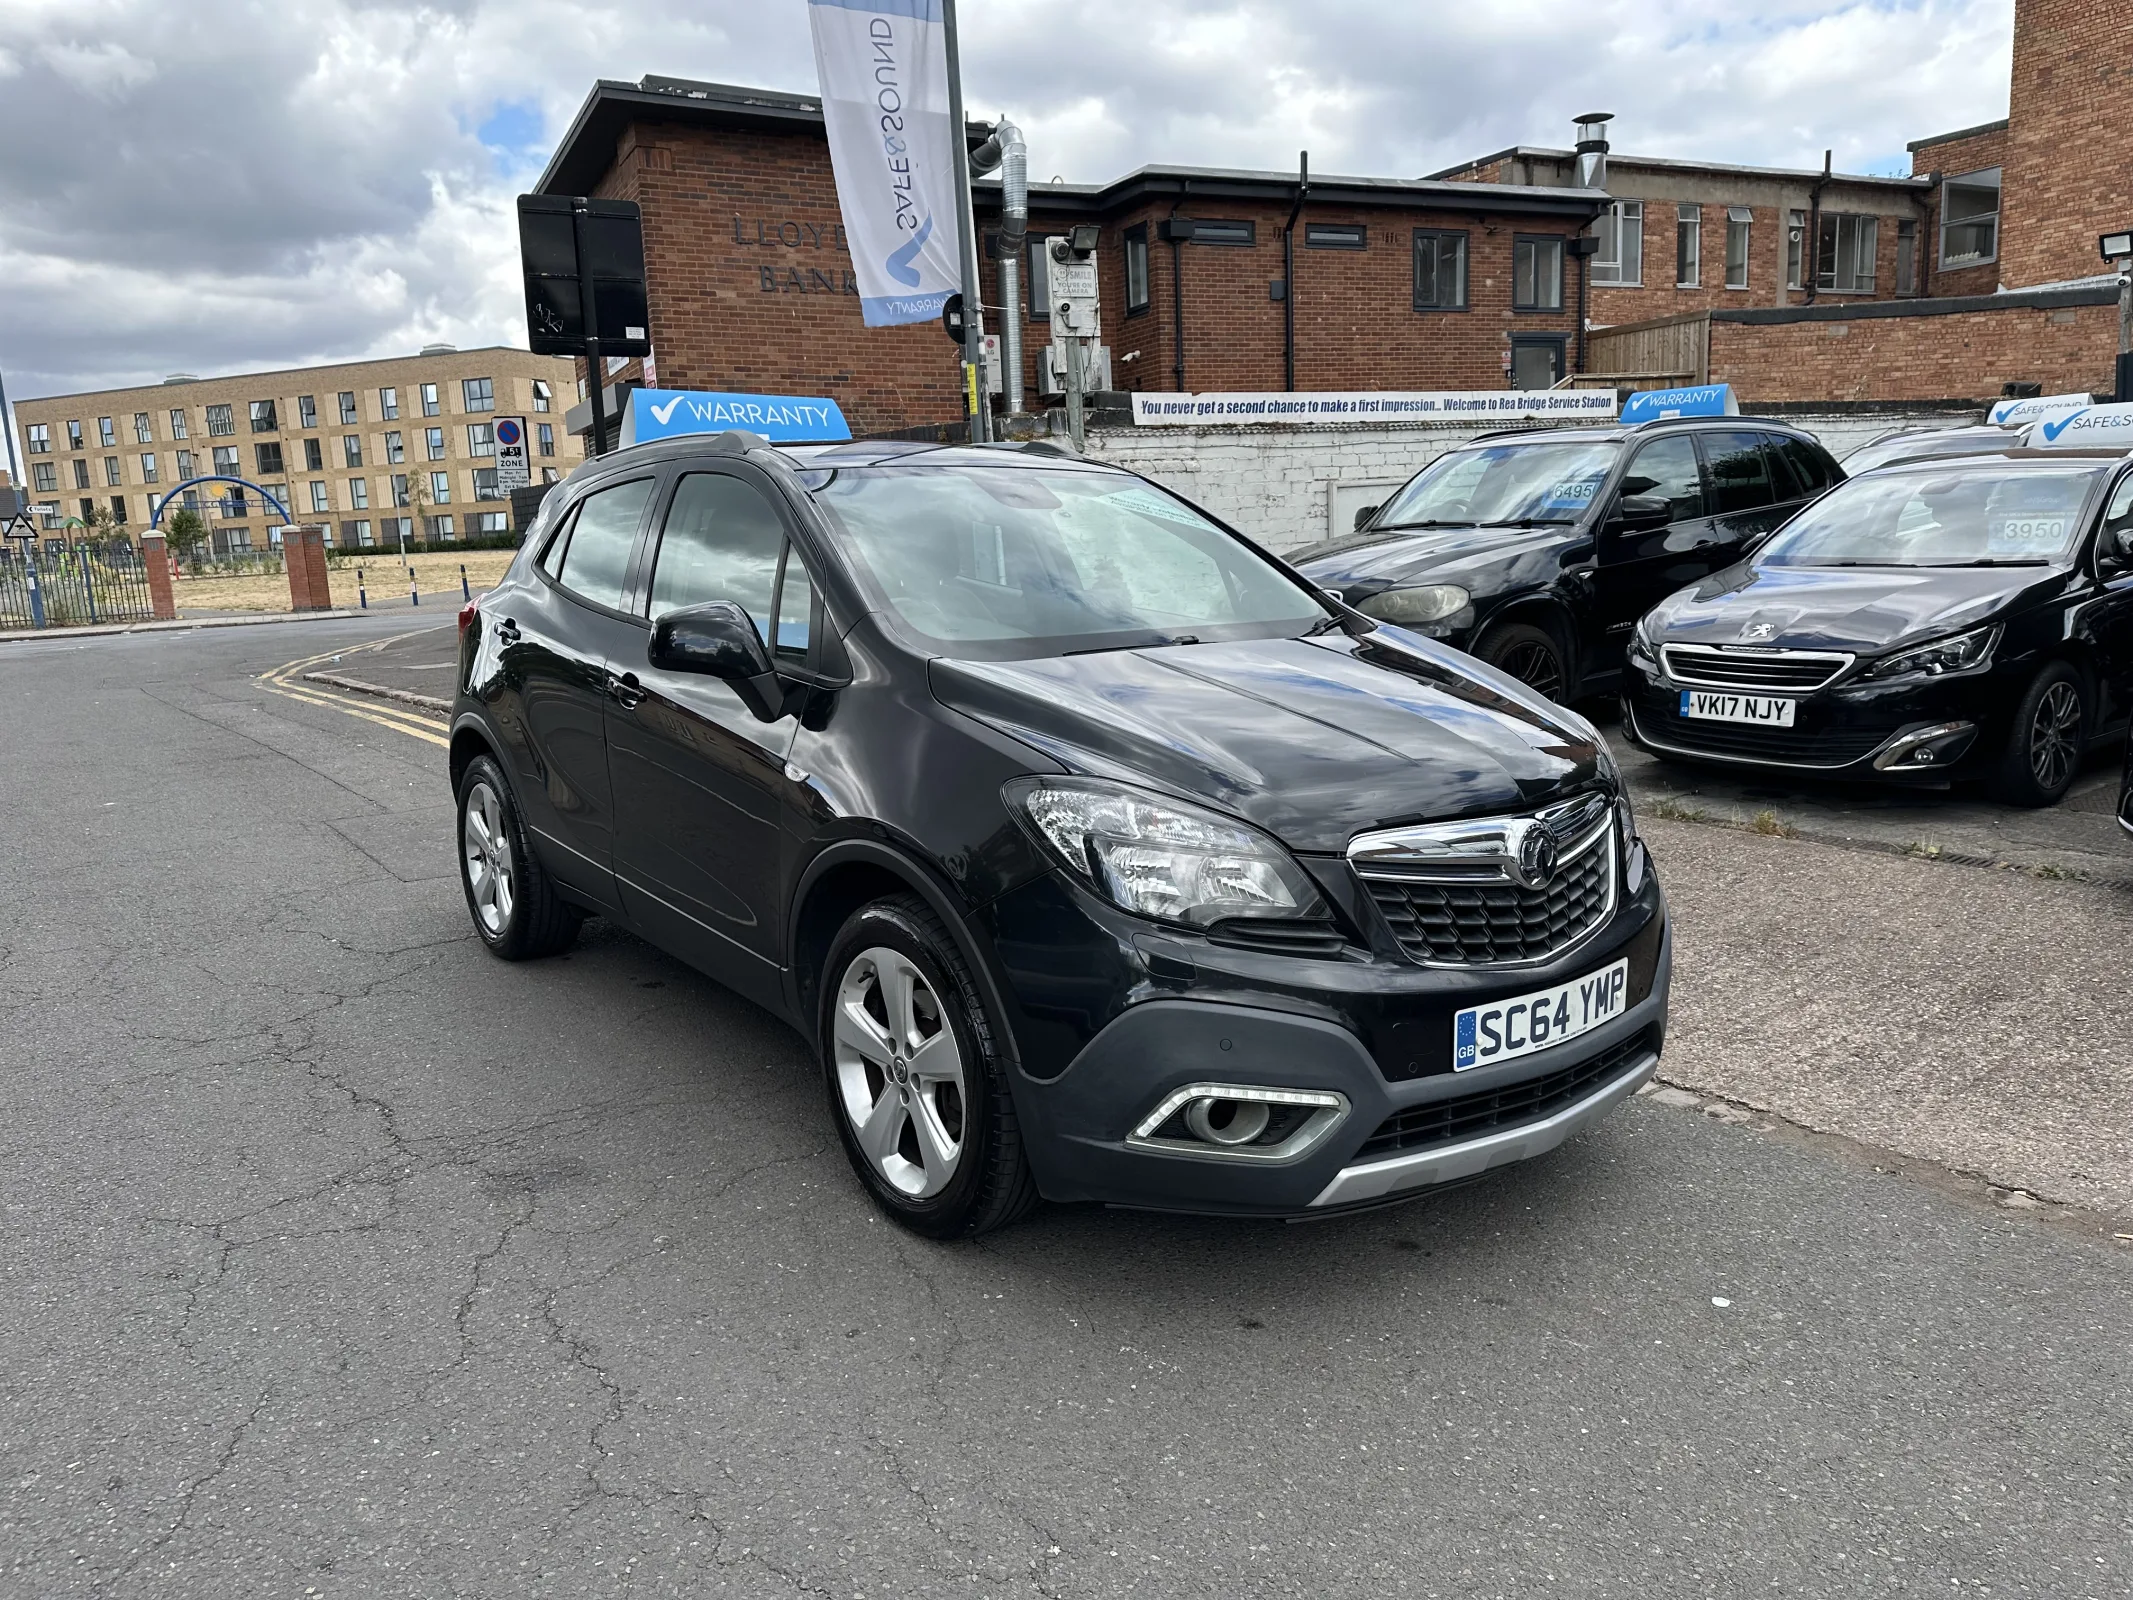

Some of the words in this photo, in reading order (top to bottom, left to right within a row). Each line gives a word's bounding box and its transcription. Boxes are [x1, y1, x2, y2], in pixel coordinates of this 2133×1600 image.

[759, 265, 859, 297] BANK
[1070, 271, 1092, 280] SMILE
[1141, 400, 1161, 414] You
[1163, 402, 1196, 414] never
[1197, 400, 1216, 416] get
[1217, 402, 1225, 414] a
[1226, 400, 1266, 414] second
[1267, 400, 1306, 413] chance
[1308, 400, 1319, 413] to
[1320, 399, 1348, 413] make
[1350, 401, 1356, 412] a
[1358, 399, 1380, 412] first
[1443, 398, 1486, 411] Welcome
[1488, 398, 1497, 410] to
[1499, 397, 1516, 410] Rea
[1517, 396, 1546, 411] Bridge
[1548, 396, 1580, 409] Service
[1581, 395, 1612, 408] Station
[1648, 389, 1721, 407] WARRANTY
[686, 400, 829, 427] WARRANTY
[2072, 414, 2133, 429] SAFE&S
[1554, 484, 1594, 498] 6495
[2005, 521, 2063, 539] 3950
[1696, 694, 1740, 717] VK17
[1744, 698, 1787, 721] NJY
[1479, 990, 1570, 1057] SC64
[1580, 966, 1625, 1025] YMP
[1458, 1044, 1475, 1059] GB
